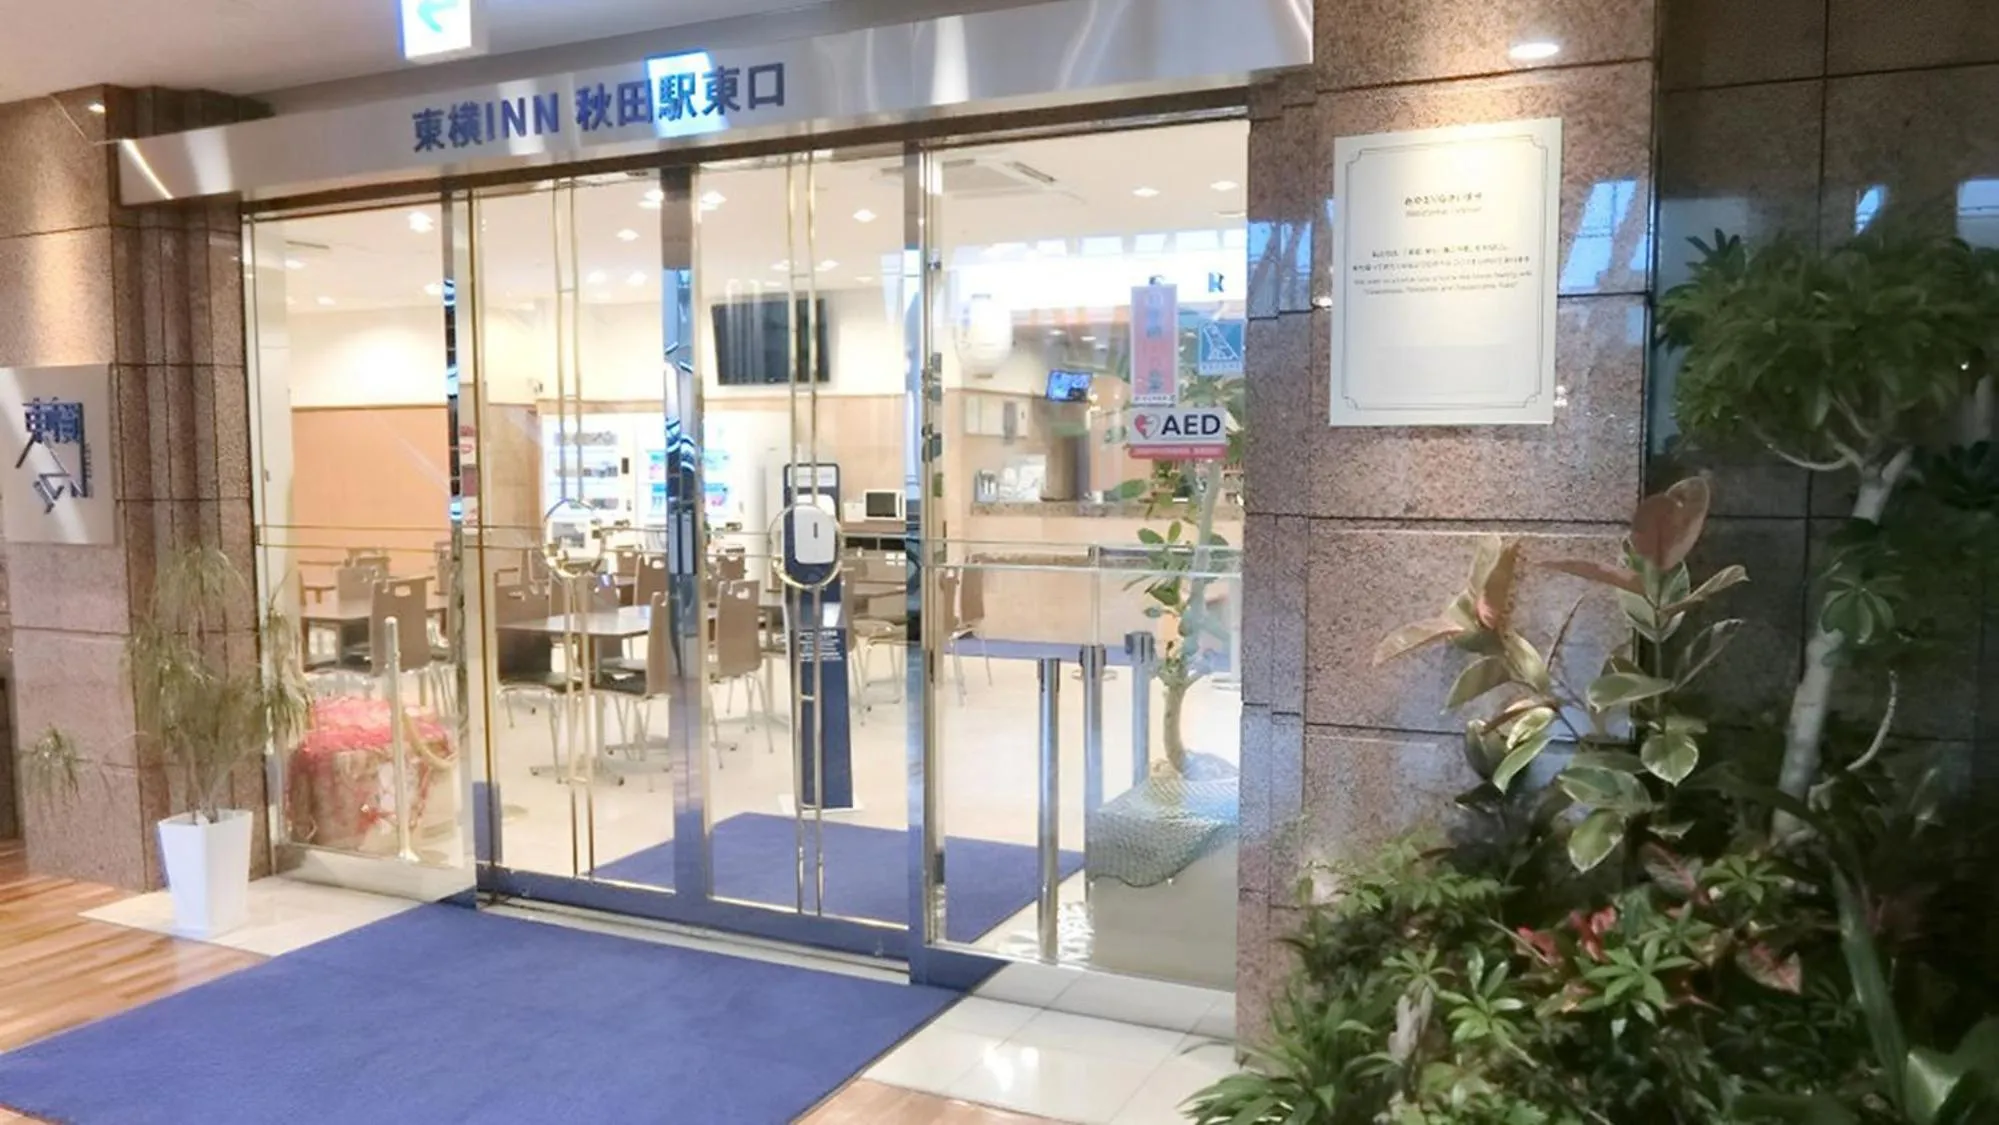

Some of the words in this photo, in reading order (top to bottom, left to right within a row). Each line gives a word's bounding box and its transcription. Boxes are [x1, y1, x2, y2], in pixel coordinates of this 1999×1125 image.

[411, 91, 560, 152] 東横INN
[574, 62, 786, 132] 秋田駅東口
[1161, 413, 1221, 437] AED
